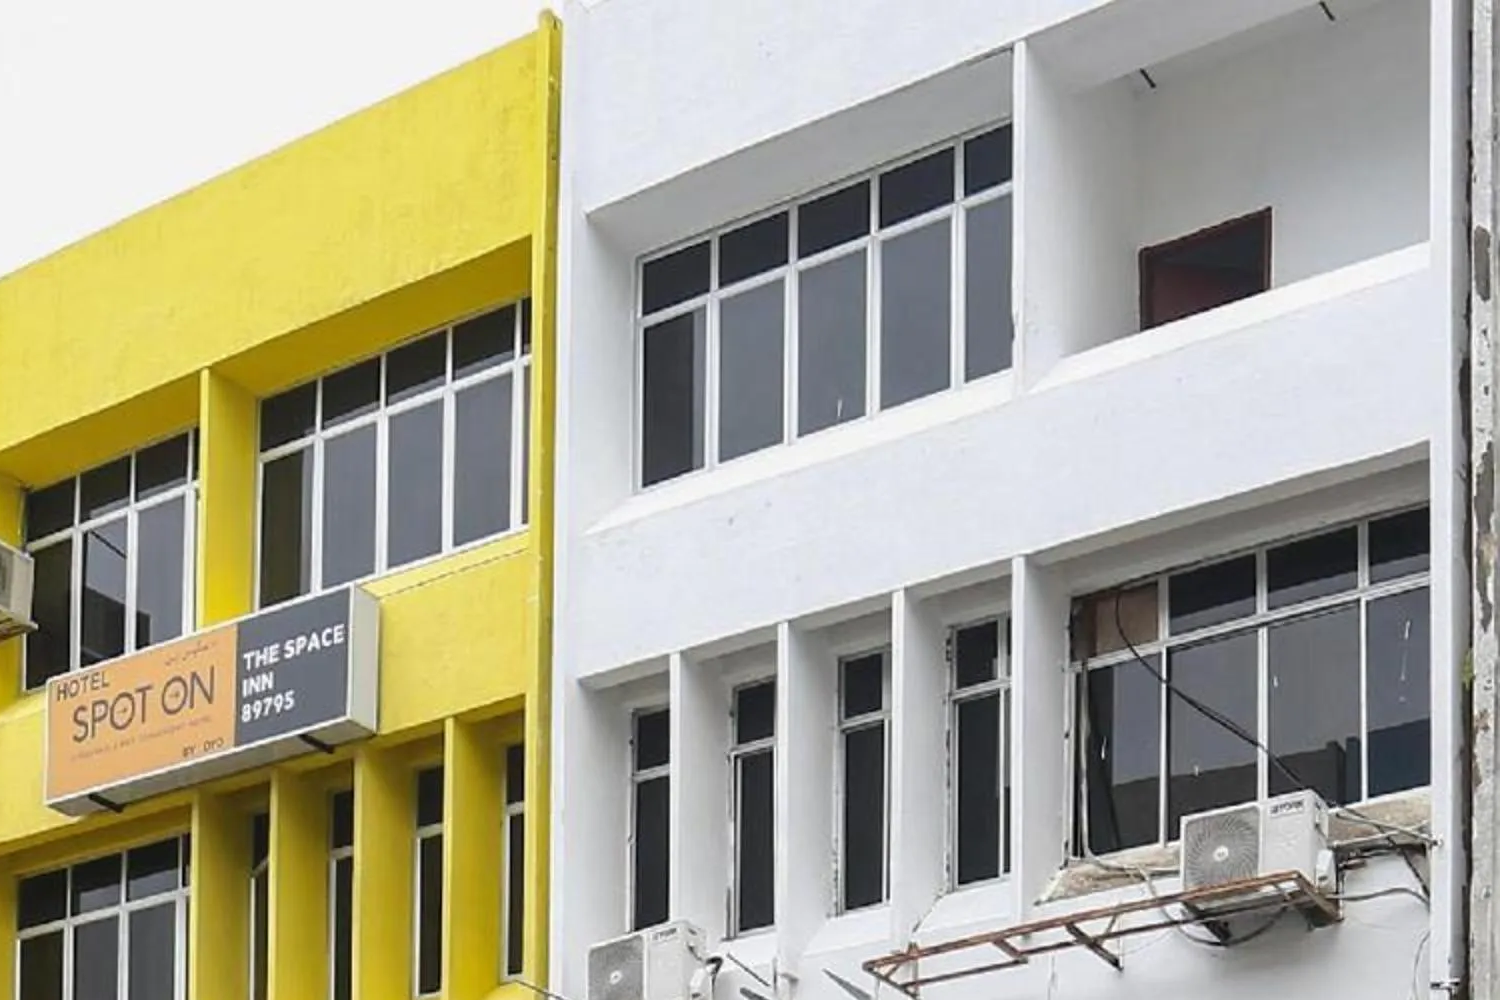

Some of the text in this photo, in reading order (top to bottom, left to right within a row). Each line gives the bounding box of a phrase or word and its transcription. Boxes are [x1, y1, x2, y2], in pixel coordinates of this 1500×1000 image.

[243, 643, 280, 671] THE
[283, 624, 345, 659] SPACE
[56, 671, 111, 701] HOTEL
[242, 671, 274, 698] INN
[72, 684, 153, 743] SPOT
[161, 665, 215, 715] ON
[241, 690, 295, 723] 89795
